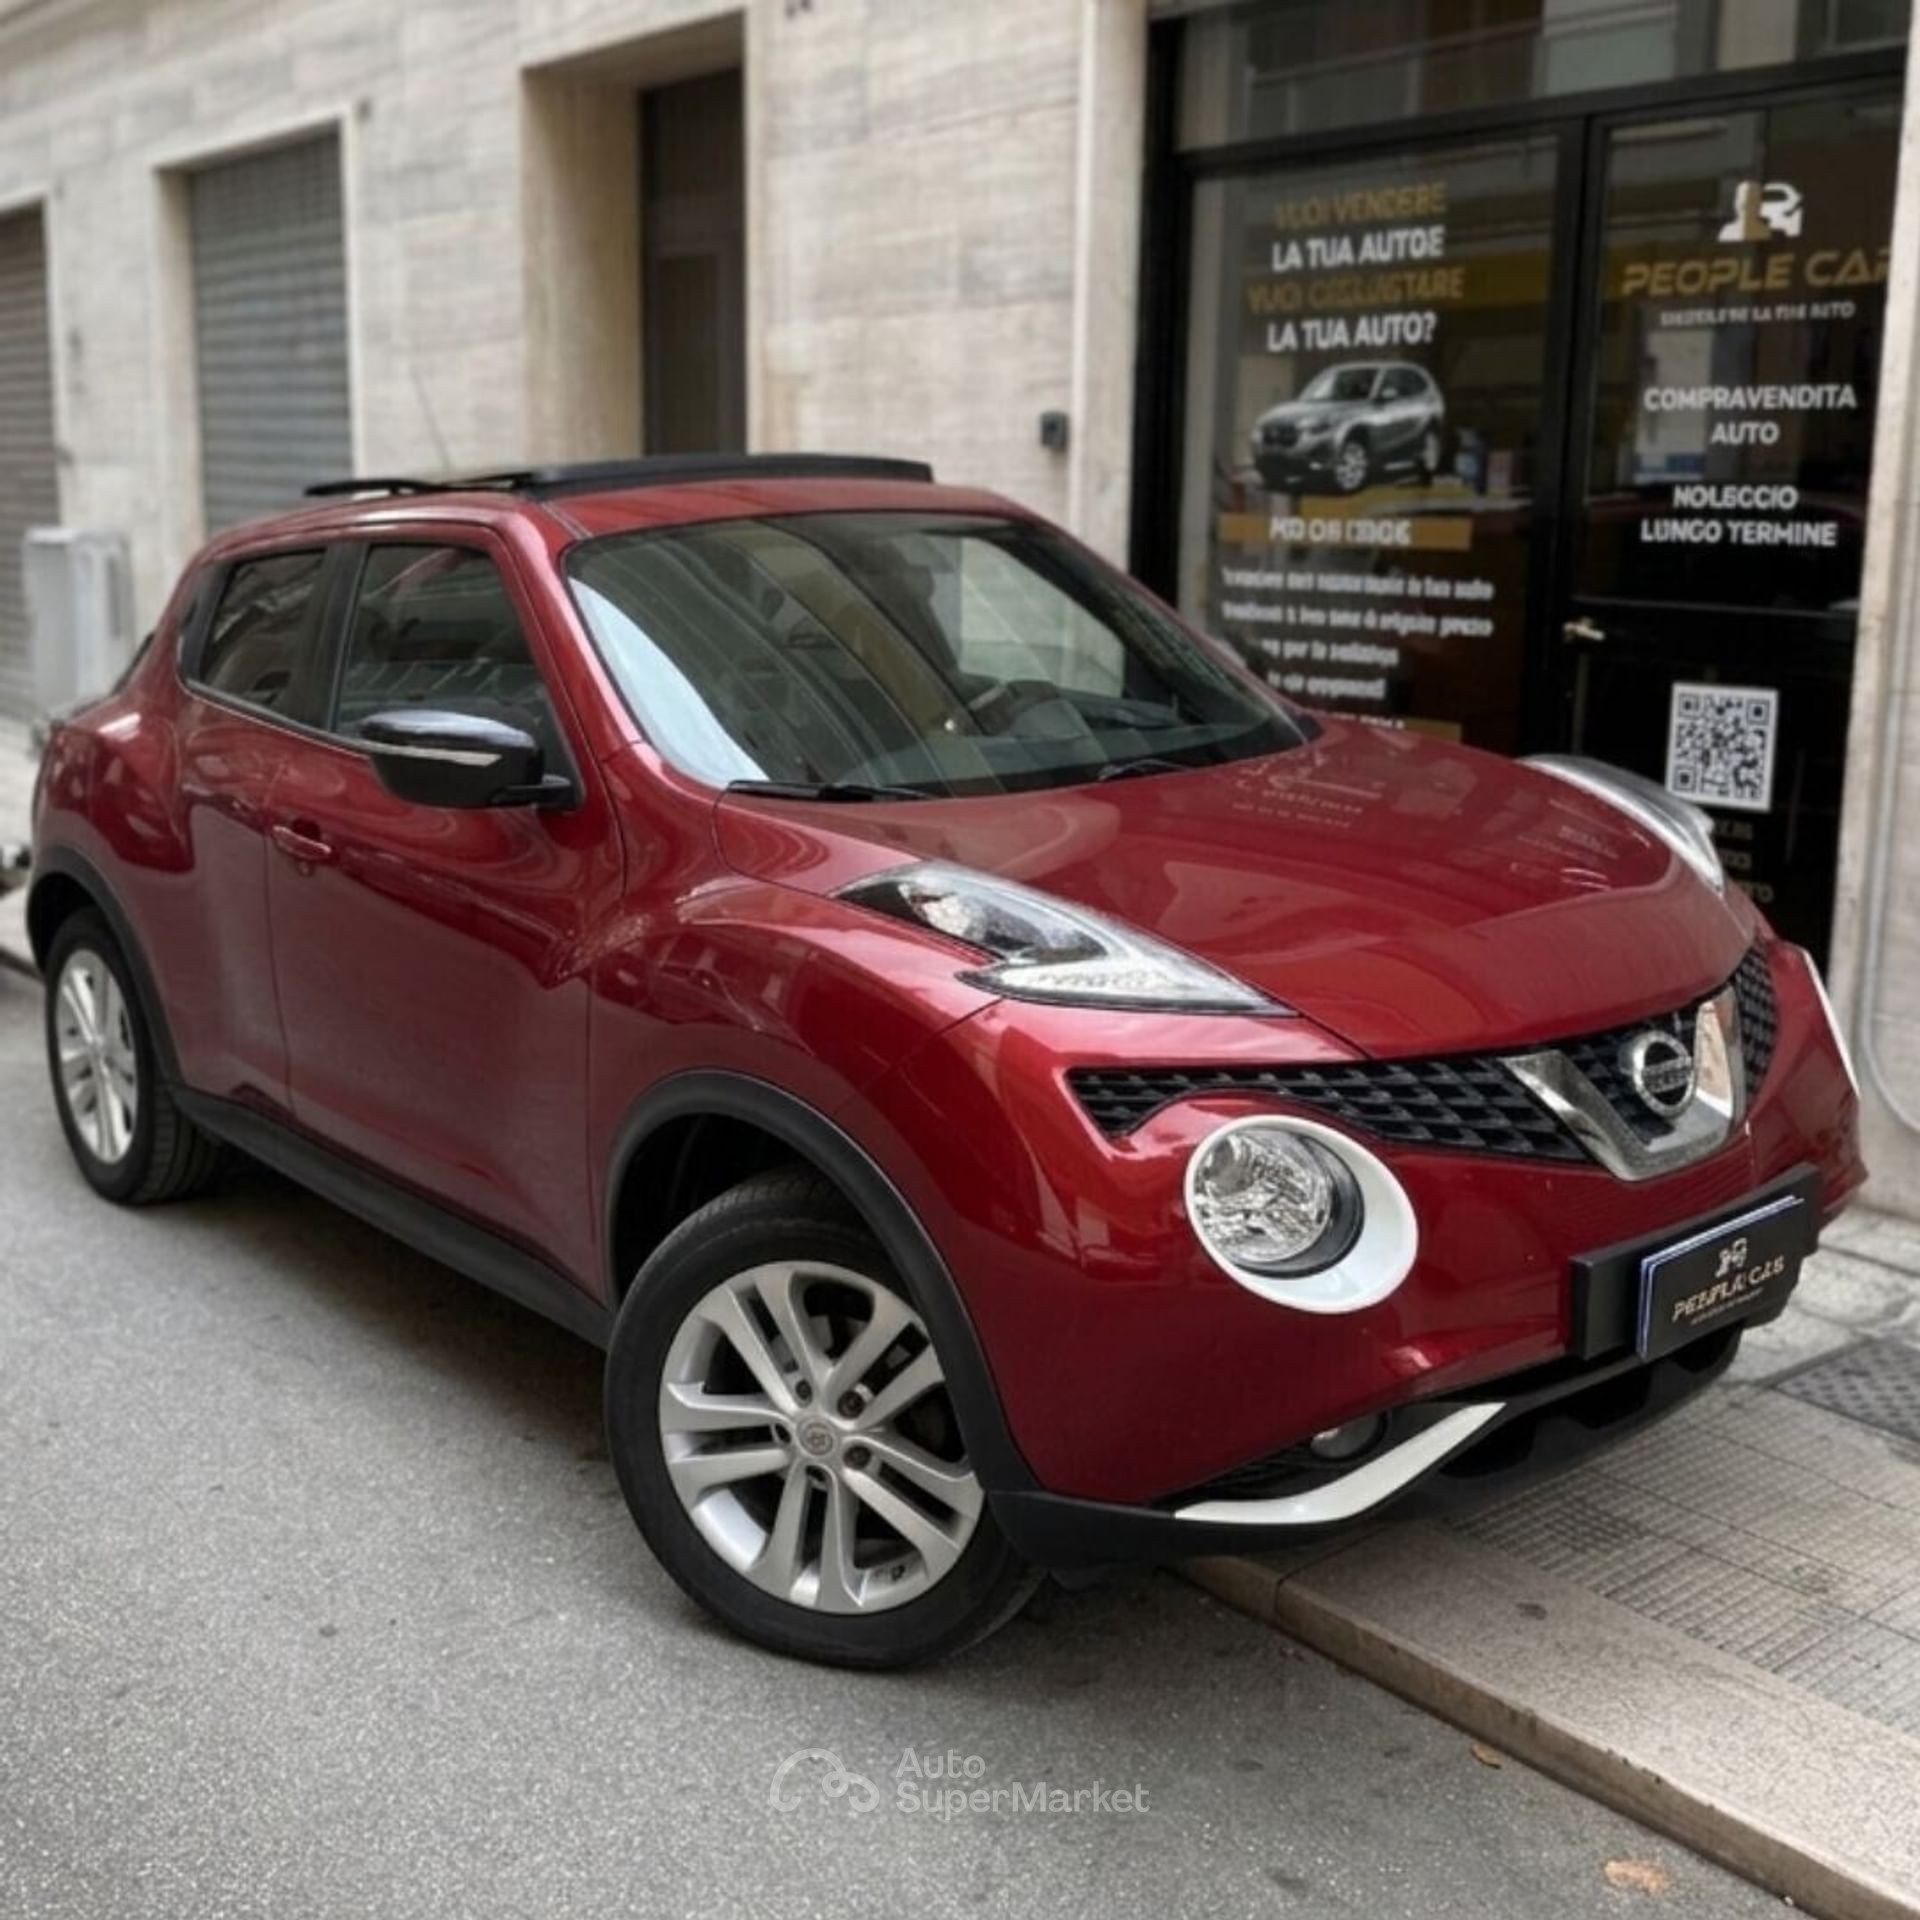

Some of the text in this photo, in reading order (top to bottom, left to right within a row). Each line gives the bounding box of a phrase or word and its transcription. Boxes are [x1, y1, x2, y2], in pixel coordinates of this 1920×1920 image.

[1271, 240, 1302, 272] LA
[1306, 234, 1354, 269] TUA
[1622, 253, 1793, 296] PEOPLE
[1266, 309, 1438, 353] LA TUA AUTO?
[1643, 383, 1859, 411] COMPRAVENDITA
[1711, 420, 1781, 446] AUTO
